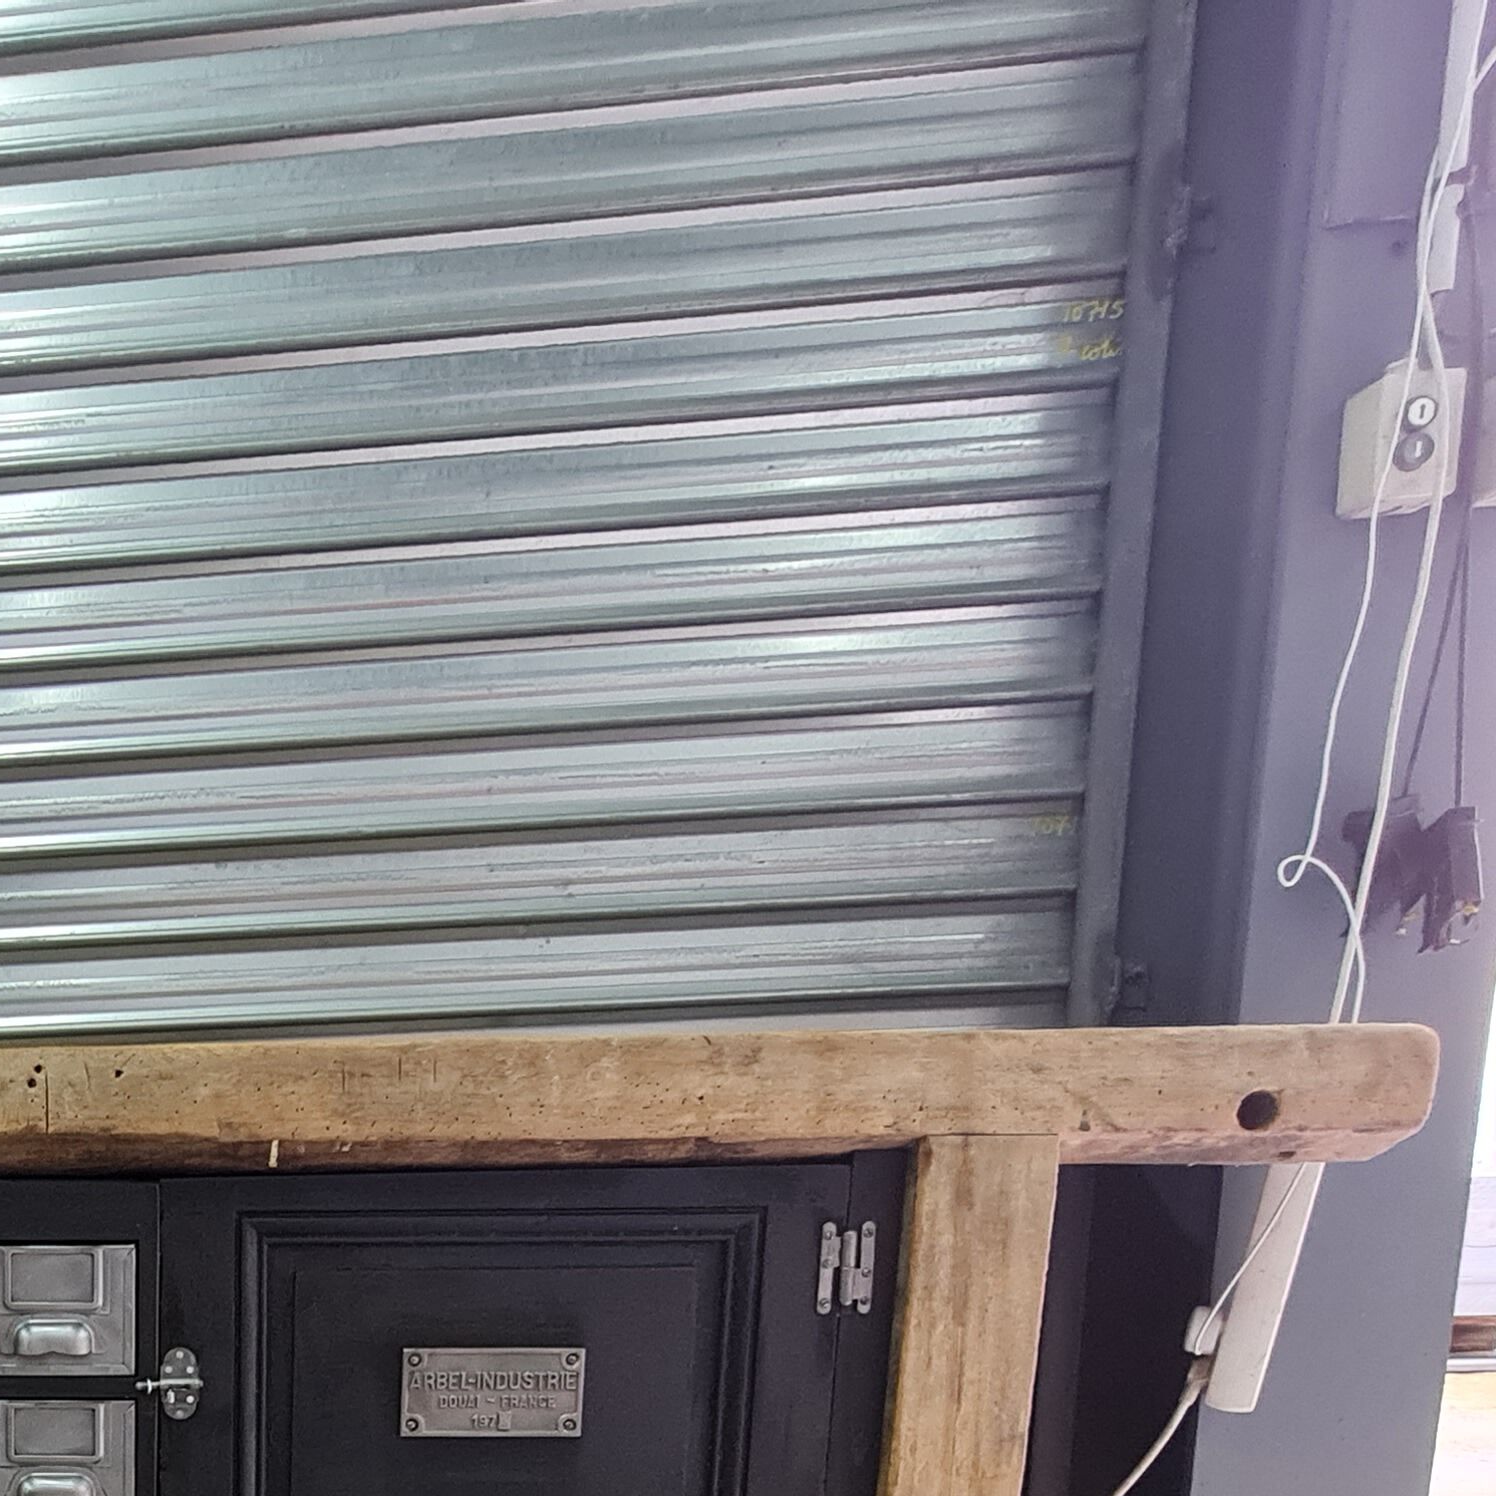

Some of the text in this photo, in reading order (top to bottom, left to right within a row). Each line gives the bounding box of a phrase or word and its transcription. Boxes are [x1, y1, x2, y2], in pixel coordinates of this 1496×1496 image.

[409, 1370, 578, 1391] ARBEL-INDUSTRIE
[439, 1394, 480, 1409] DOUAI
[502, 1394, 557, 1409] FRANCE
